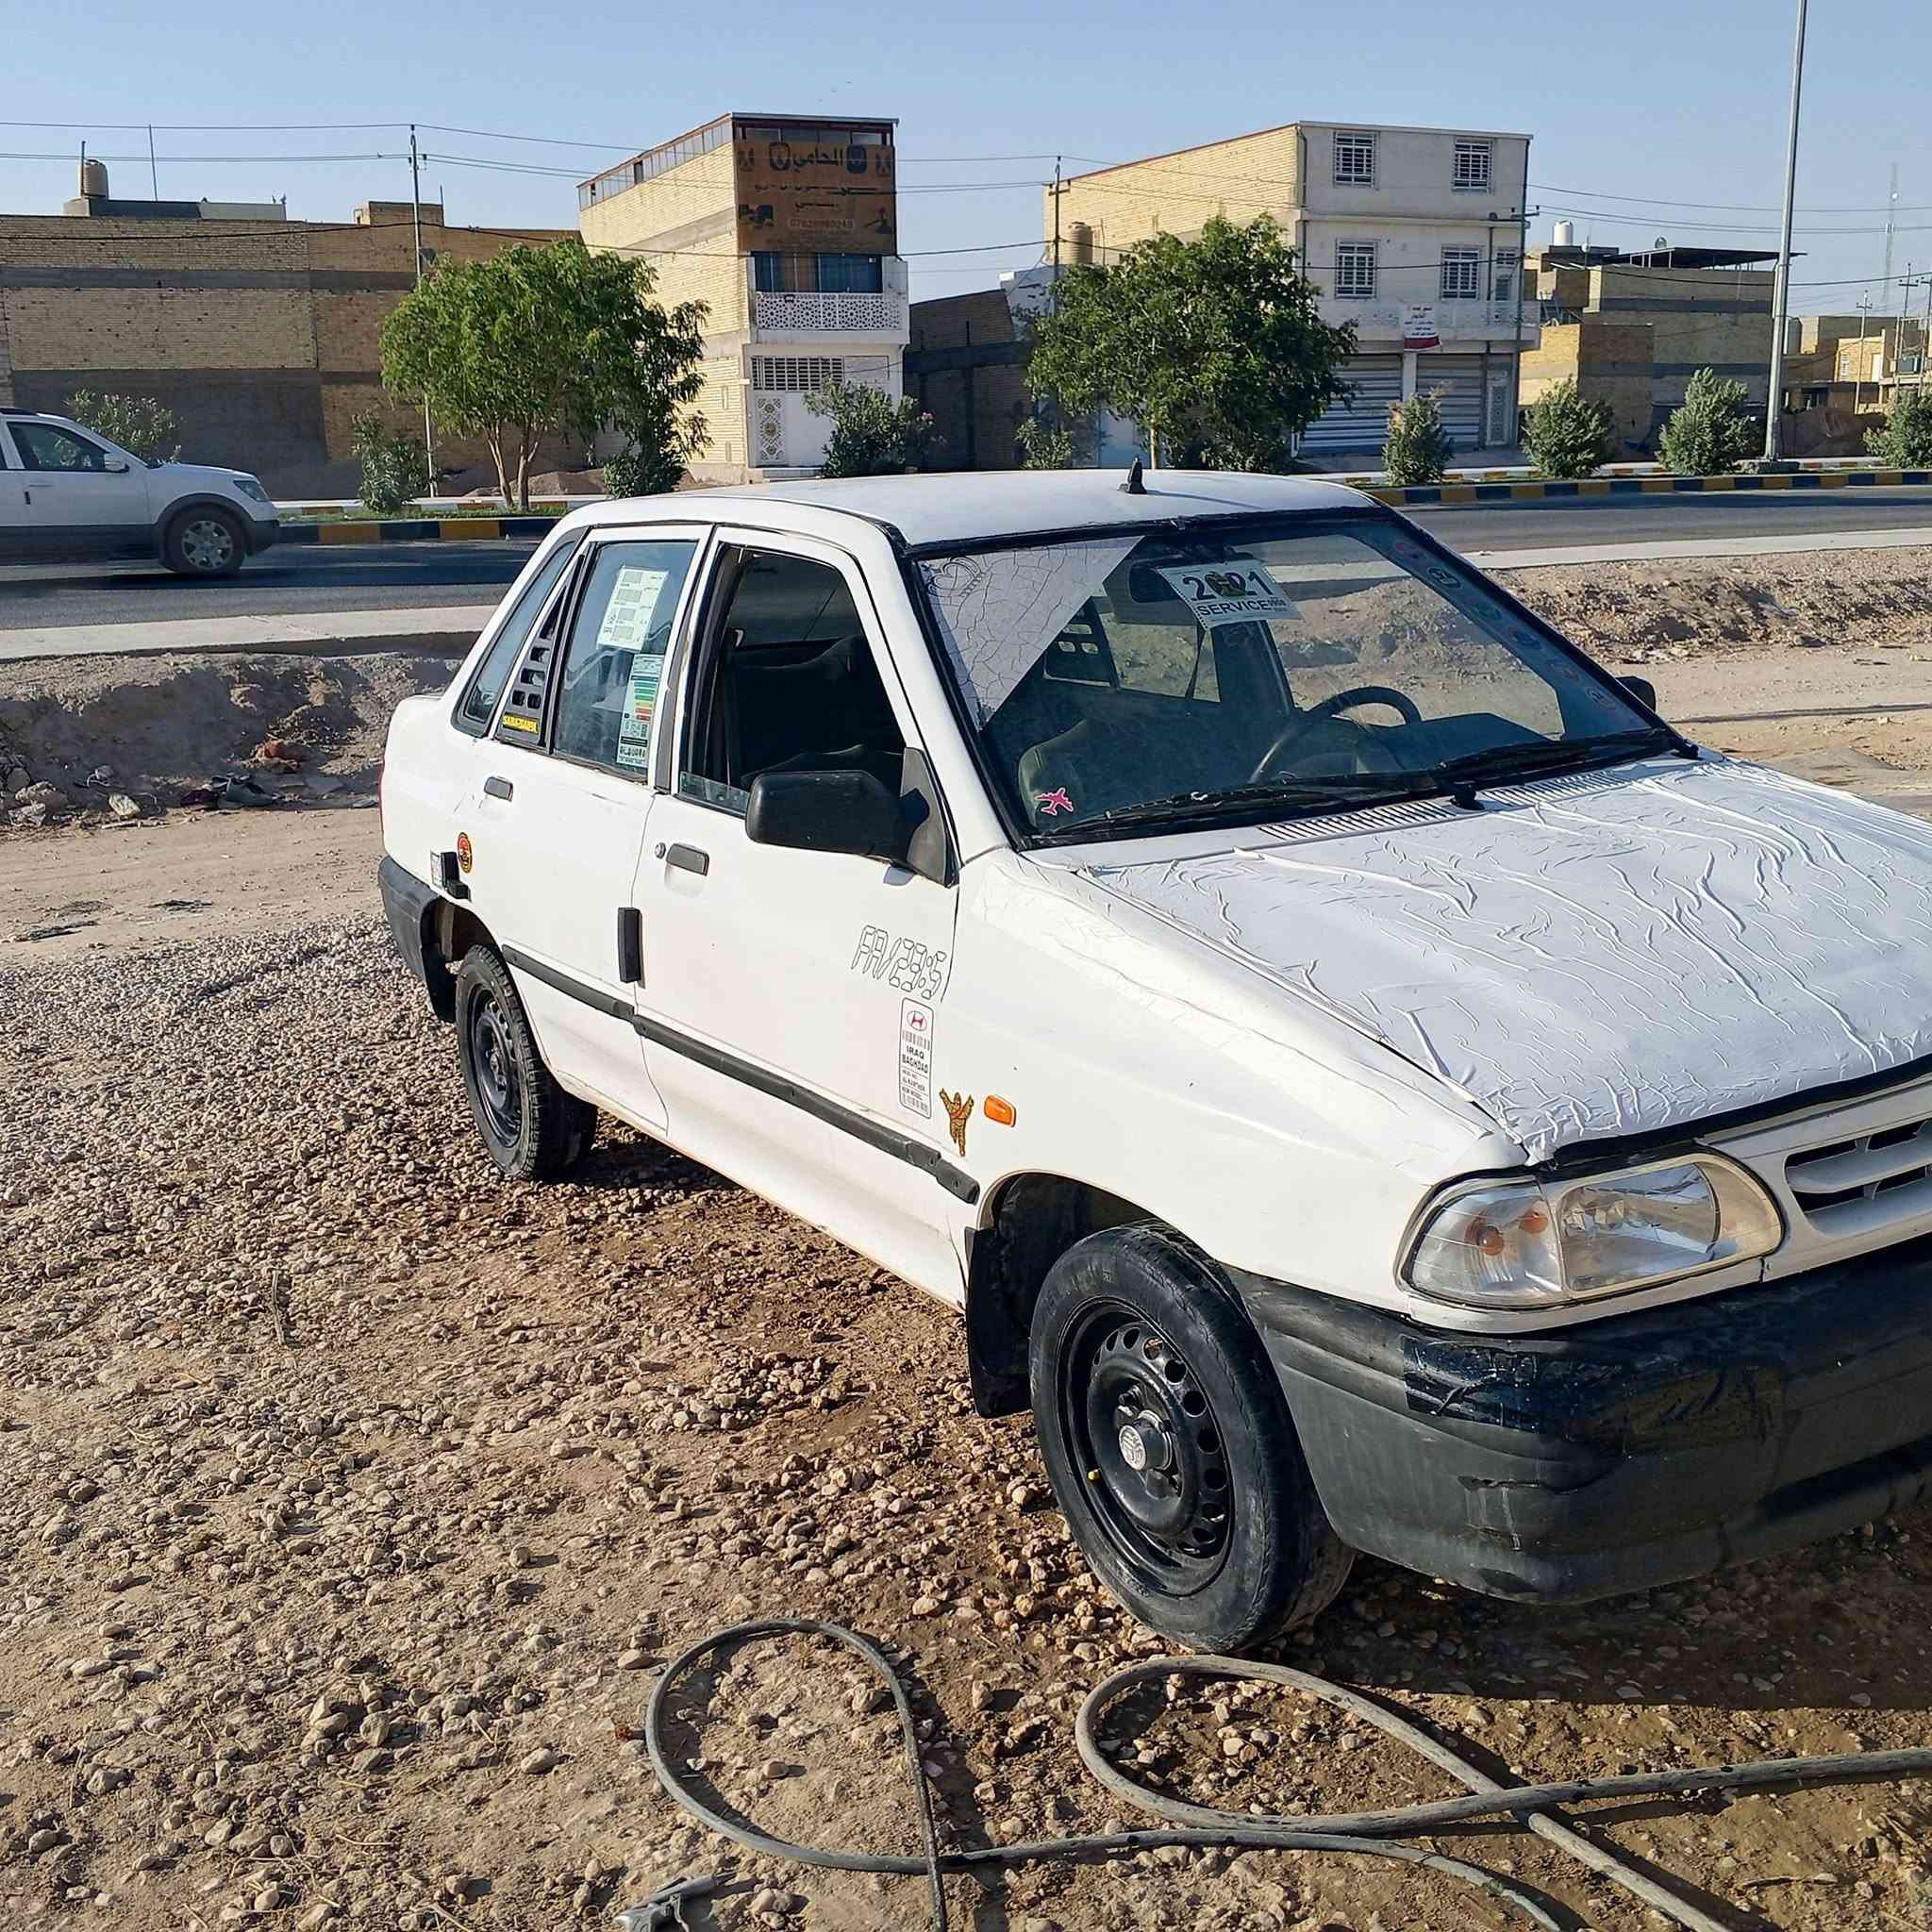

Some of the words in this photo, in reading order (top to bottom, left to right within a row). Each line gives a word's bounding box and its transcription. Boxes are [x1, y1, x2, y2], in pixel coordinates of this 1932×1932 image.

[1197, 599, 1270, 616] SERVICE
[907, 1044, 924, 1059] IRAQ
[902, 1054, 928, 1074] BAGHDAD
